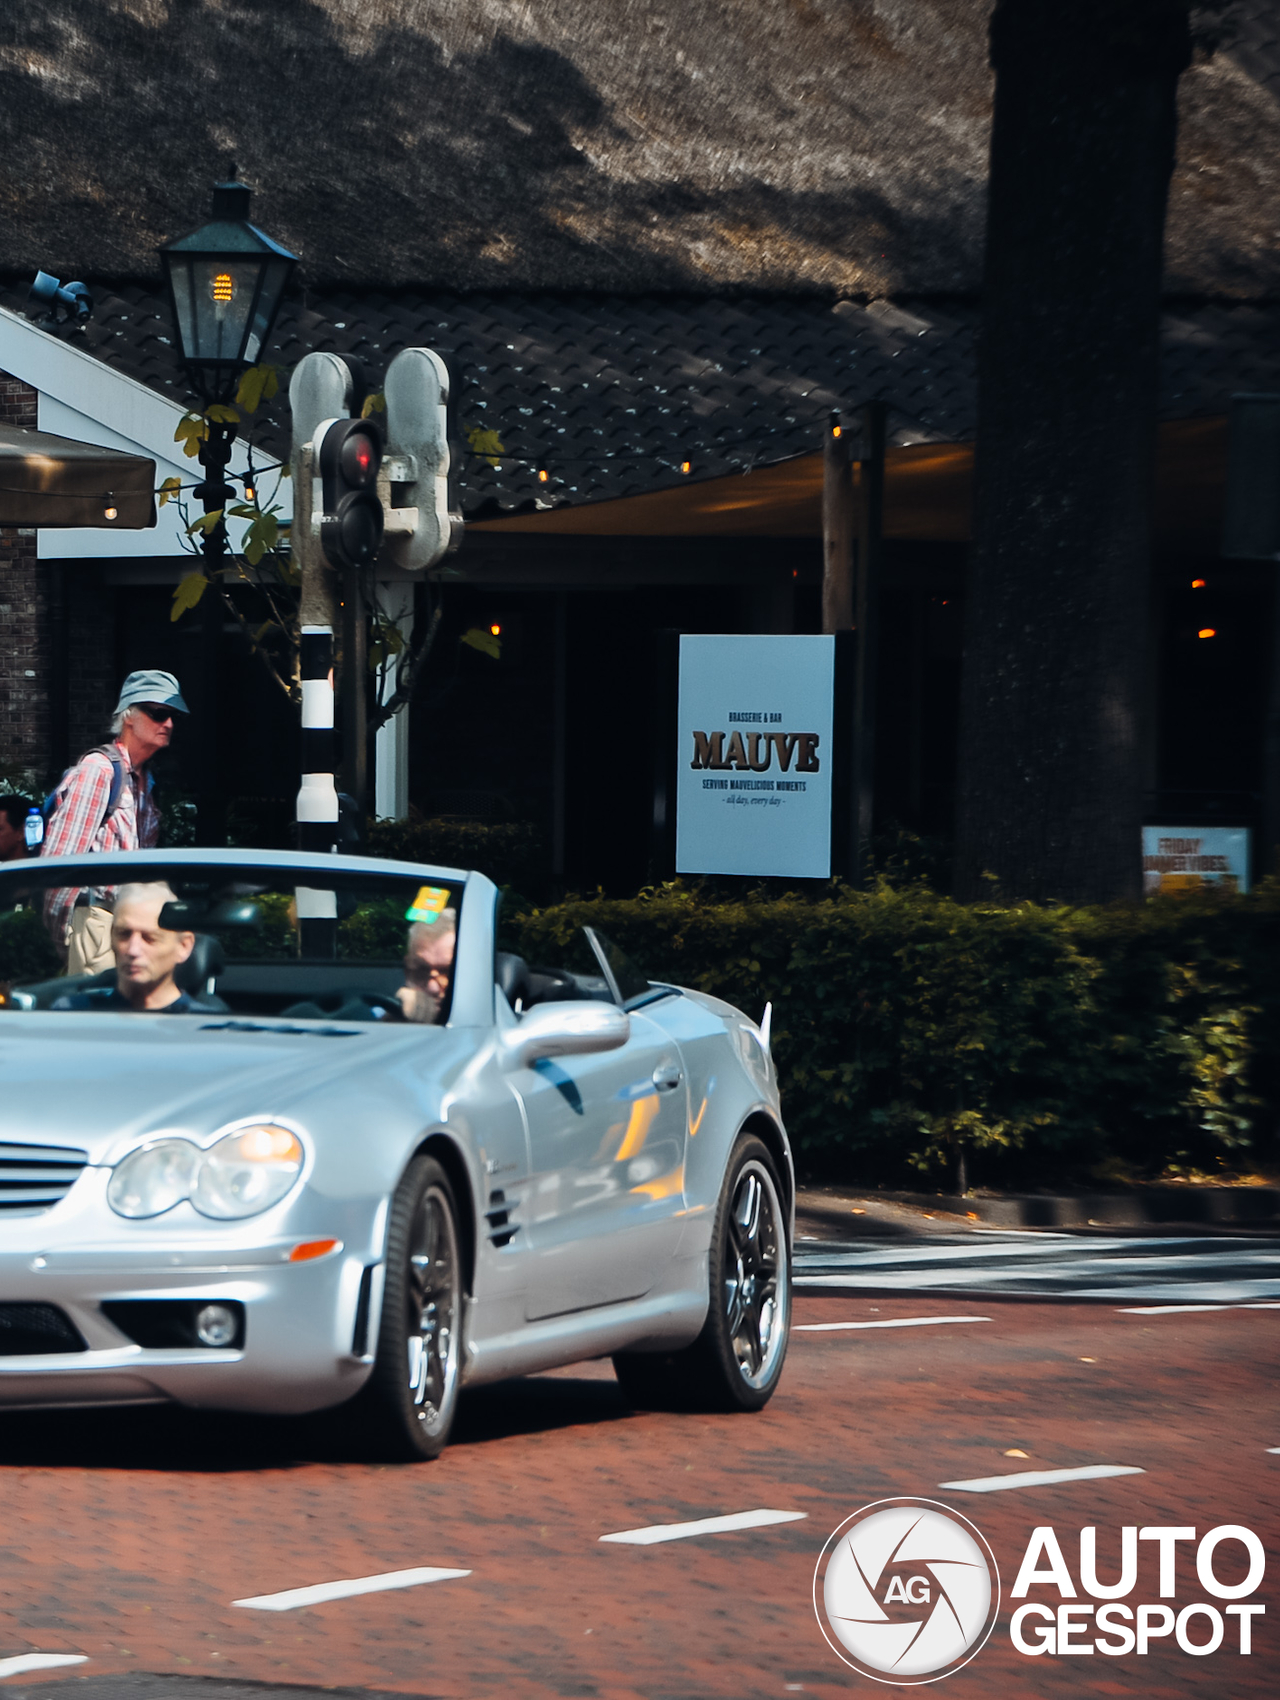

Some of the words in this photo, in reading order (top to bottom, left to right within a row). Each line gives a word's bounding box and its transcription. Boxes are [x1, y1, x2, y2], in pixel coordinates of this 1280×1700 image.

[728, 712, 762, 723] BRASSERIE
[763, 713, 768, 723] &
[769, 713, 782, 723] BAR
[690, 730, 820, 772] MAUVE
[702, 779, 729, 790] SERVING
[730, 780, 774, 791] MAUVELICIOUS
[776, 781, 806, 792] MOMENTS
[750, 797, 768, 807] every
[1158, 838, 1202, 854] FRIDAY
